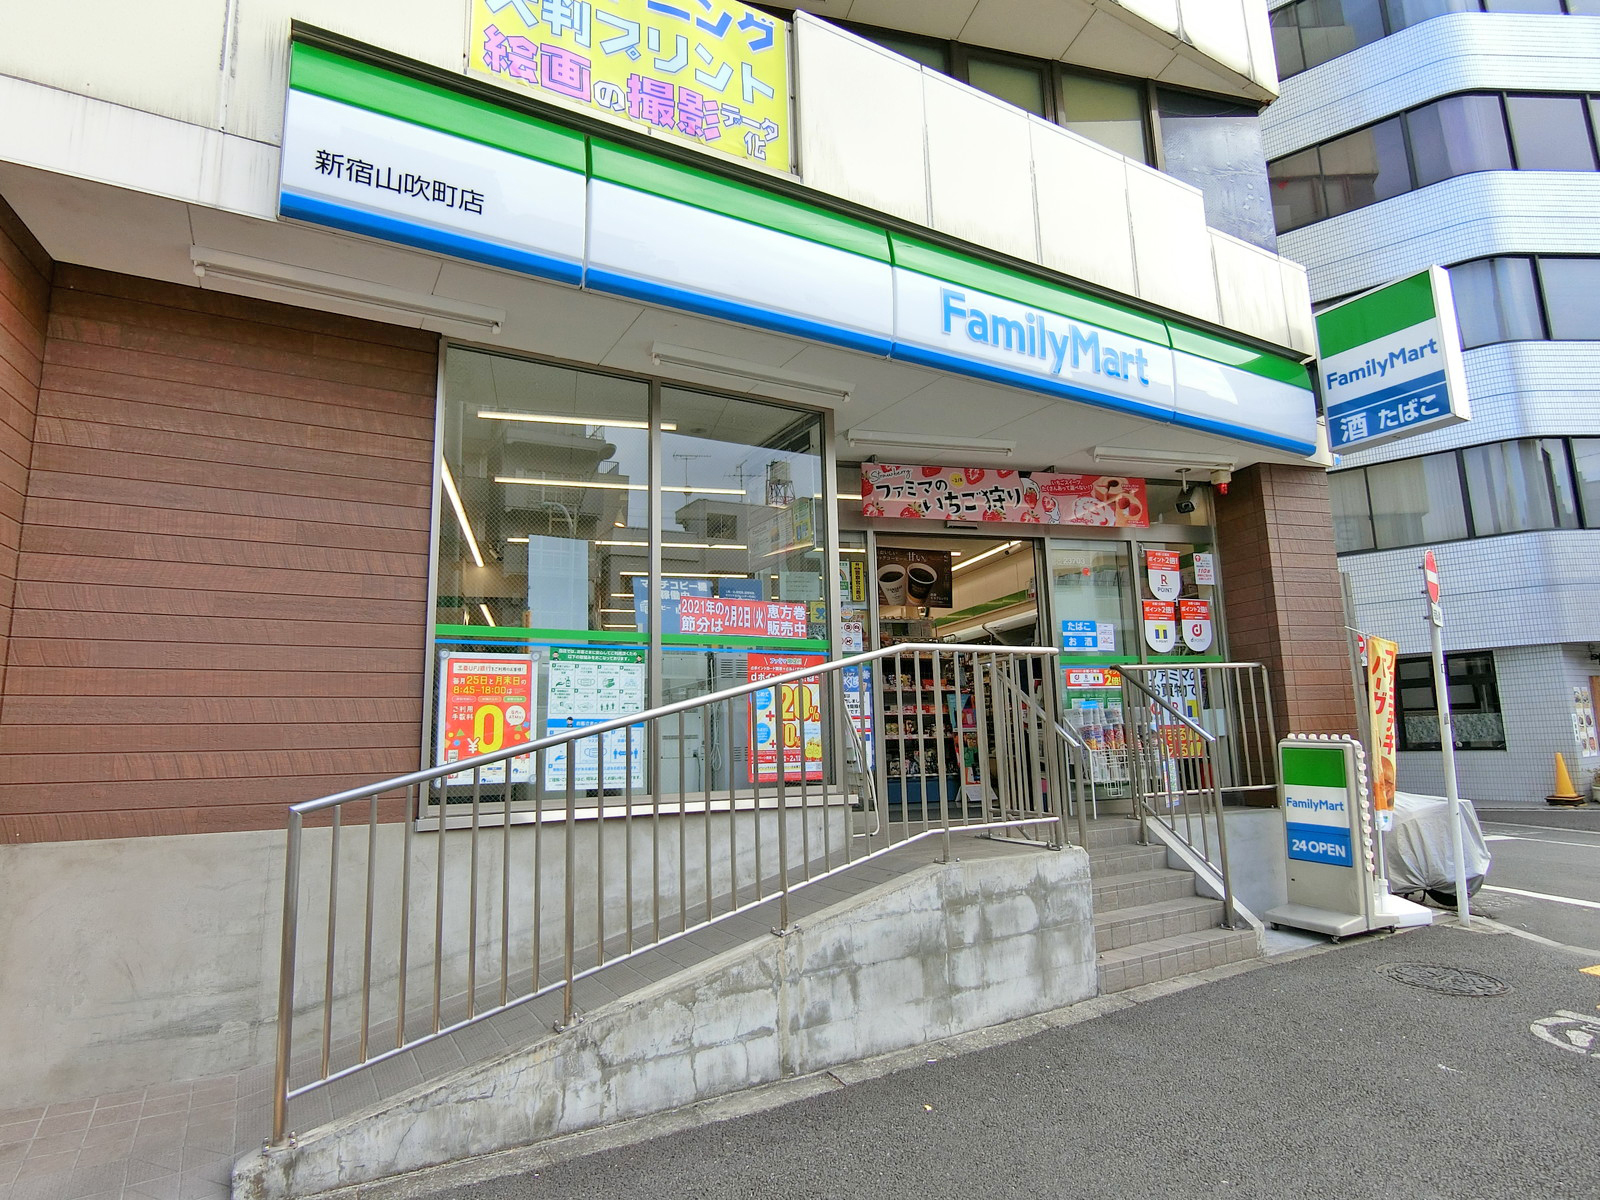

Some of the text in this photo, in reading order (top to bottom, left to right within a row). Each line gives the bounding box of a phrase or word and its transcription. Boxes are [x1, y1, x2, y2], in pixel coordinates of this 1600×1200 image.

[315, 150, 484, 215] 新宿山吹町店
[940, 287, 1149, 388] FamilyMart
[1326, 338, 1438, 390] FamilyMart
[1340, 394, 1440, 442] 酒 たばこ
[876, 480, 948, 499] ファミマの
[922, 486, 1021, 514] いちご狩り
[681, 599, 724, 615] 2021年の
[725, 606, 766, 629] 2月2日(火)
[767, 604, 806, 621] 恵方巻
[681, 616, 724, 632] 節分は
[767, 621, 807, 637] 販売中
[1067, 622, 1091, 631] たばこ
[1371, 655, 1387, 715] バーグ
[1286, 797, 1344, 813] FamilyMart
